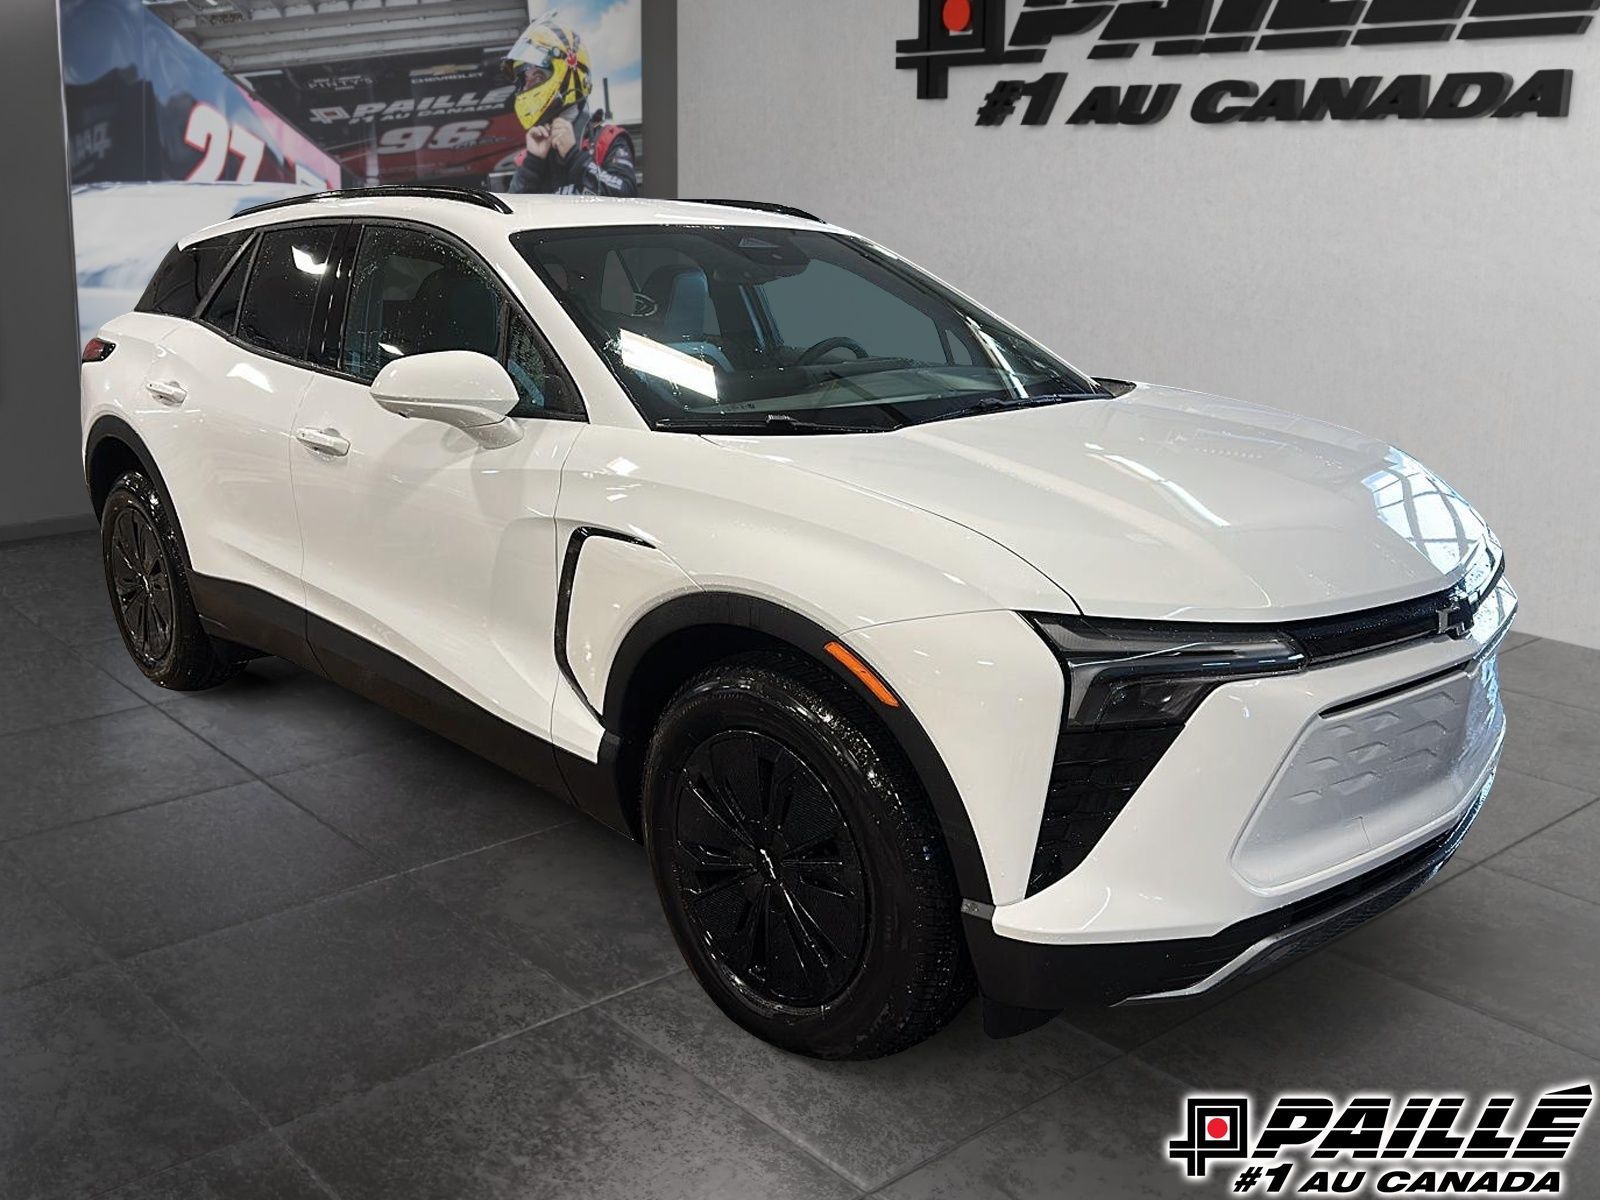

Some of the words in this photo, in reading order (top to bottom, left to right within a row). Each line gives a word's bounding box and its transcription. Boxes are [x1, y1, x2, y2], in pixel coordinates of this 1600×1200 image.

[380, 112, 411, 121] AU
[417, 103, 505, 117] CANADA
[975, 72, 1068, 126] #1
[1065, 83, 1182, 125] AU
[1190, 69, 1574, 124] CANADA
[184, 101, 266, 184] 27
[377, 119, 490, 155] 96
